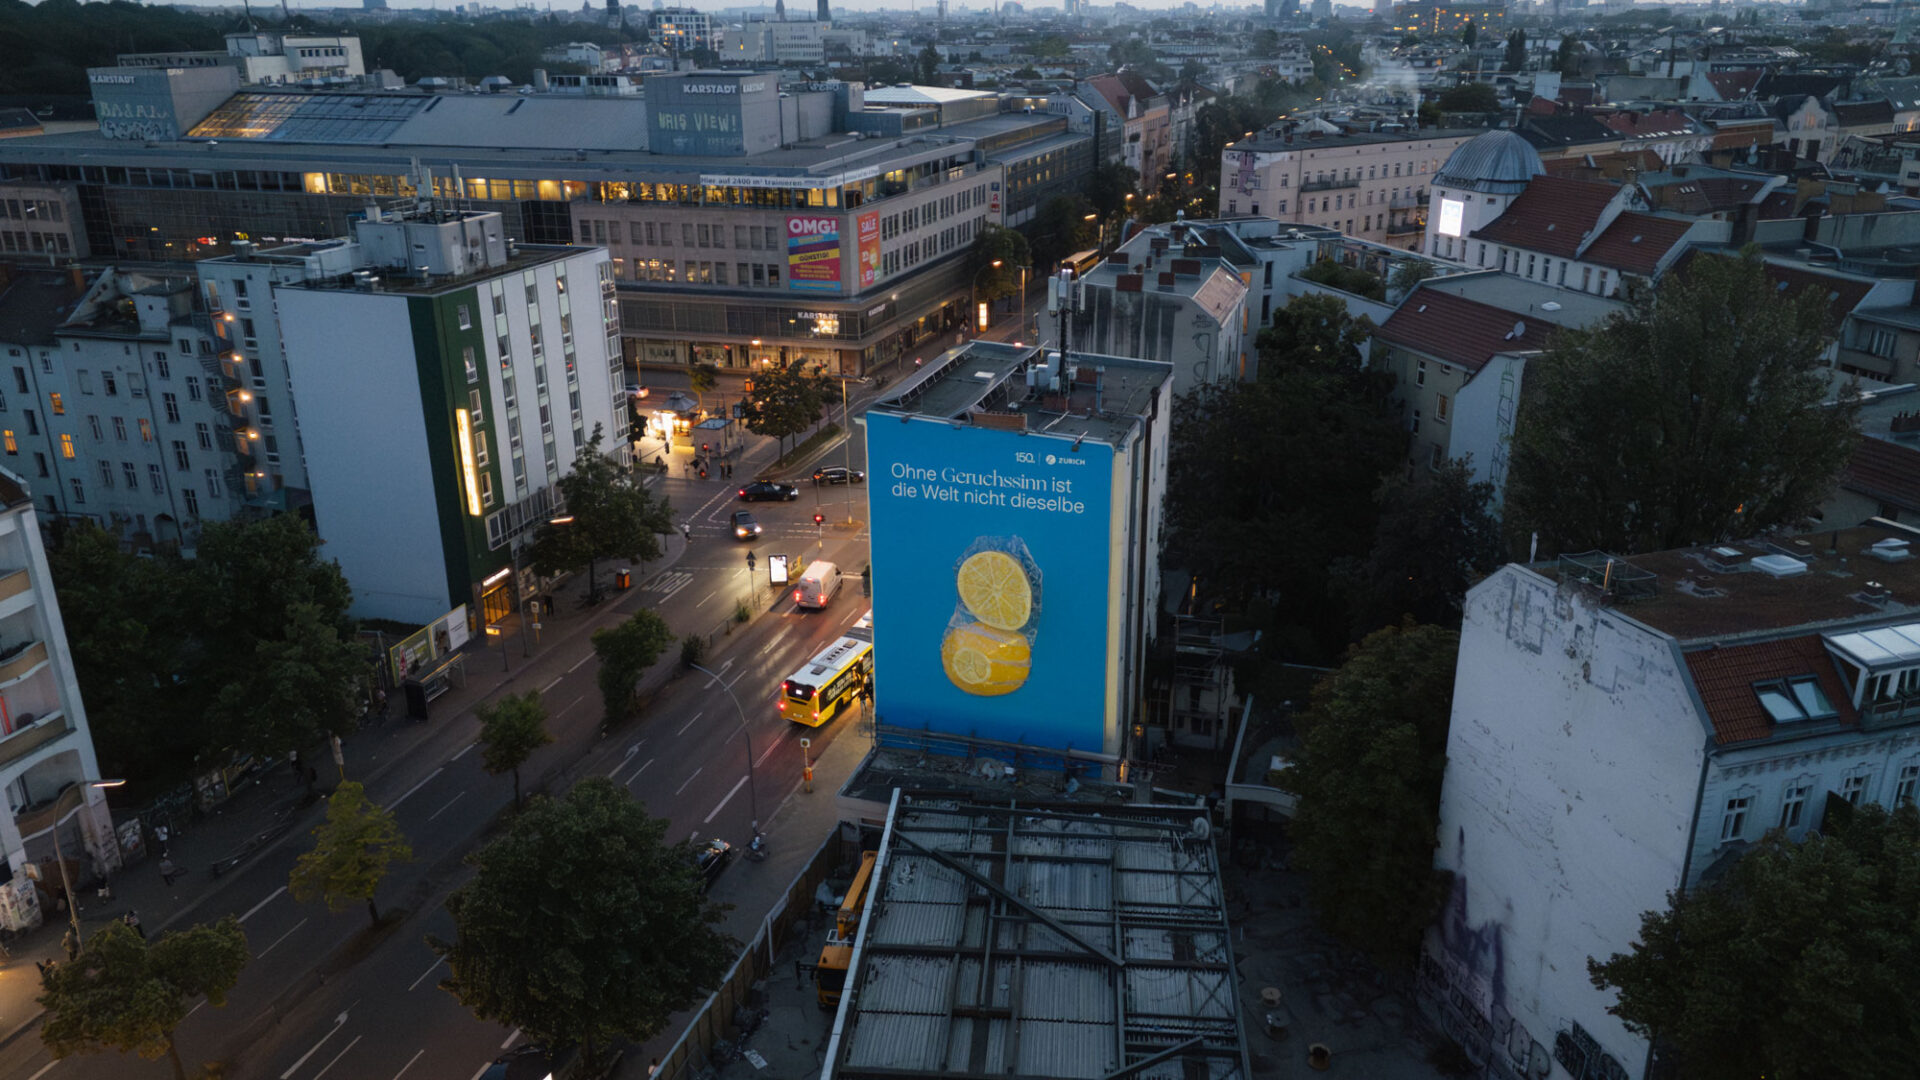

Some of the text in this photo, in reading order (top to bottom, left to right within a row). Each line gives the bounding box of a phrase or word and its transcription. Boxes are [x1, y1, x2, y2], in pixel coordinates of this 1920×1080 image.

[683, 84, 737, 94] KARSTADT
[789, 219, 836, 234] OMG!
[861, 218, 876, 233] SALE
[797, 312, 839, 320] KARSTADT
[1058, 457, 1085, 465] ZURICH
[891, 462, 1072, 494] Ohne Geruchssinn ist
[891, 481, 1085, 514] die Welt nicht dieselbe
